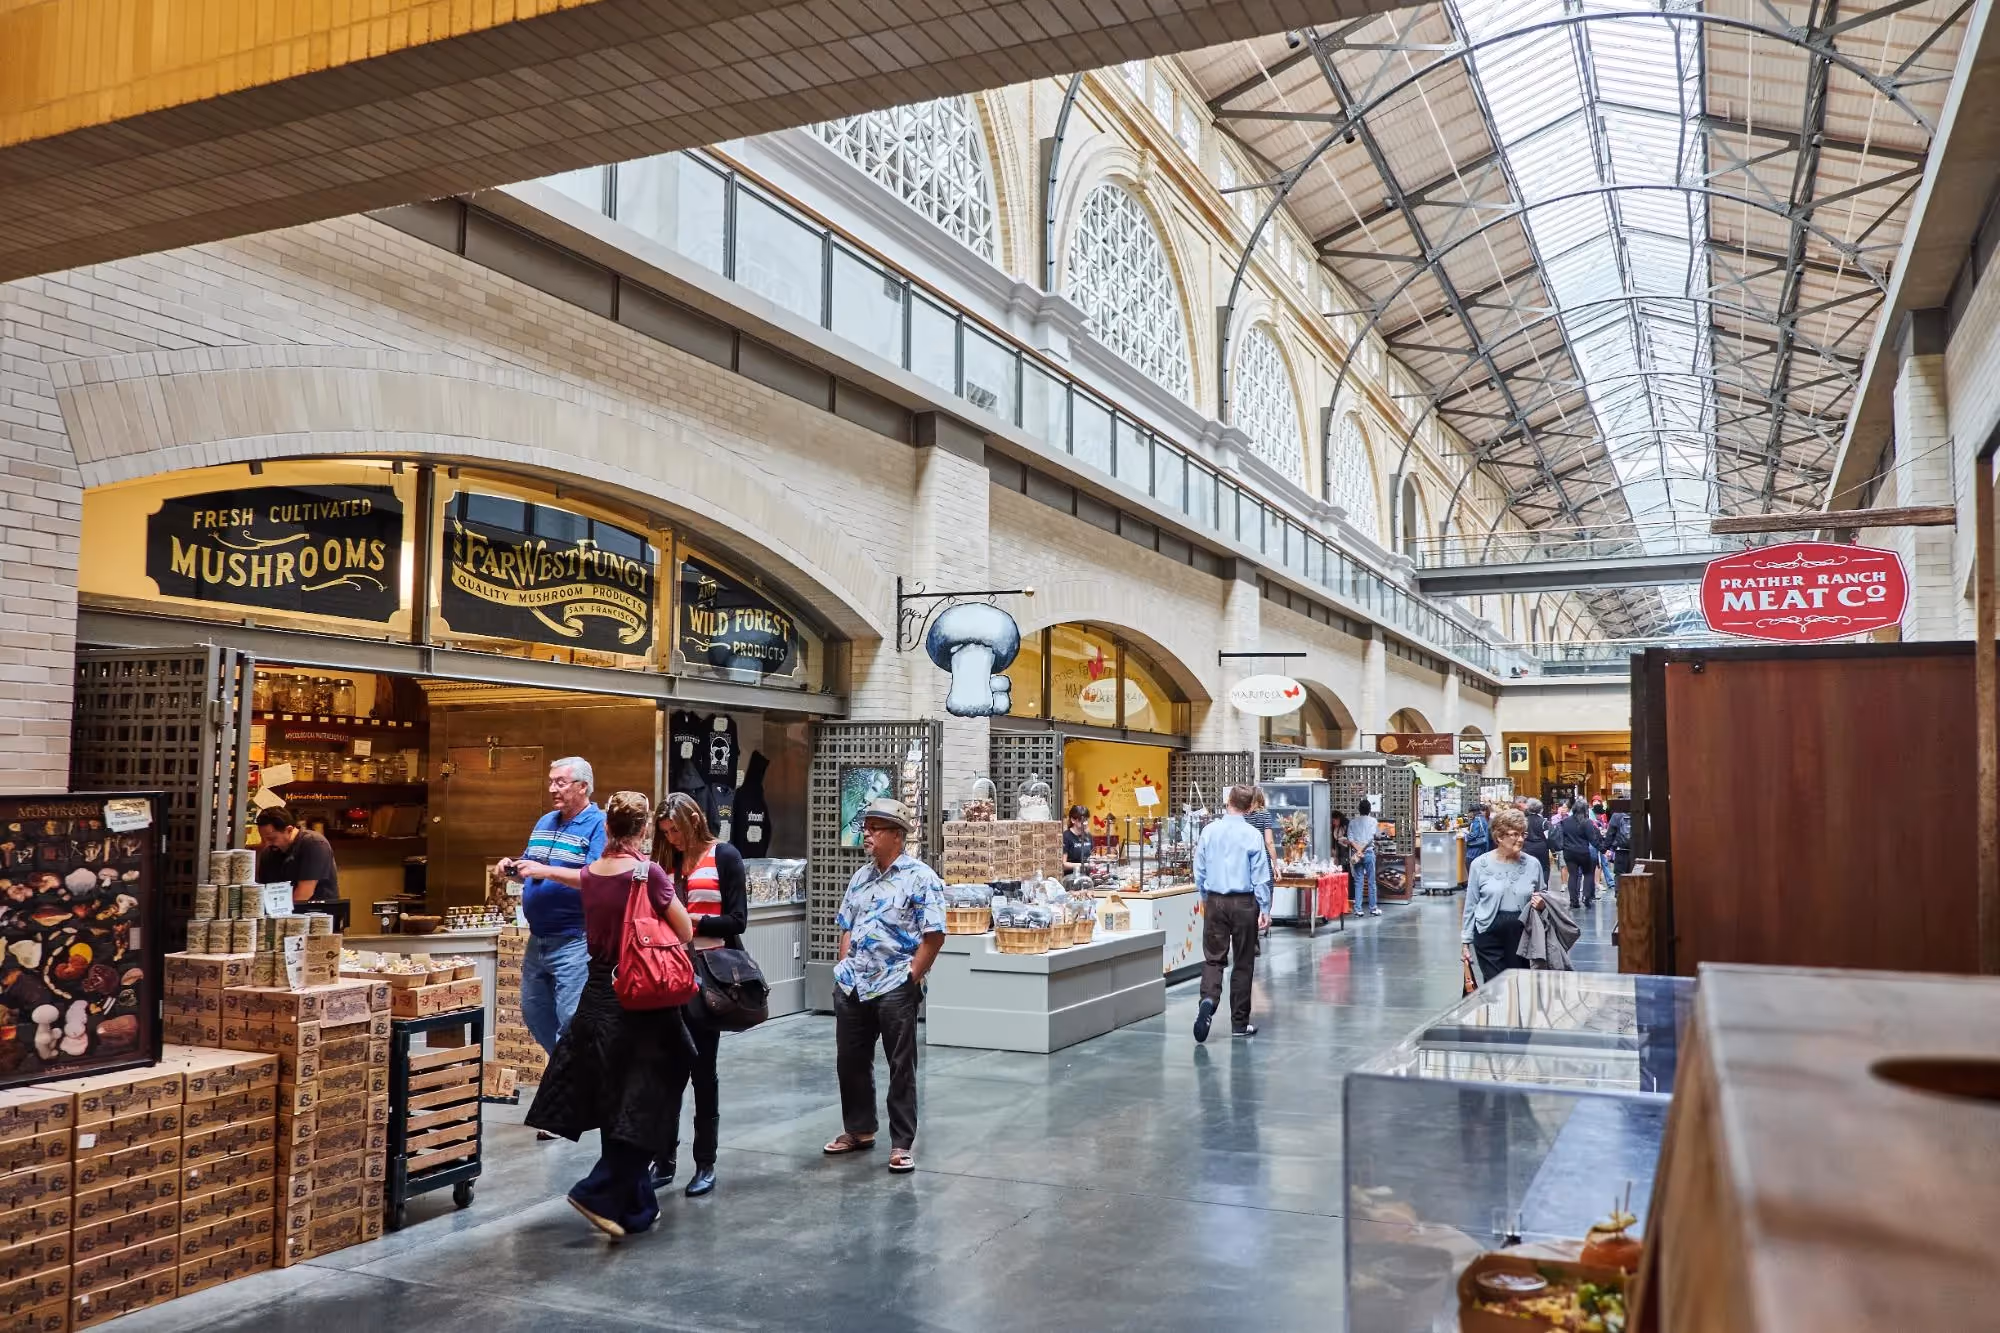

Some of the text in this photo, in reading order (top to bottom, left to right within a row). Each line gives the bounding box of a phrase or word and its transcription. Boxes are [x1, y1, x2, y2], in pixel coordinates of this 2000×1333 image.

[193, 498, 372, 529] FRESH CULTIVATED
[170, 535, 387, 588] MUSHROOMS
[458, 575, 643, 612] QUALITY MUSHROOM PRODUCTS
[697, 583, 717, 600] AND
[1720, 571, 1887, 590] PRATHER RANCH
[1720, 587, 1829, 613] MEAT
[569, 605, 636, 624] SAN FRANCISCO
[688, 604, 790, 642] WILD FOREST
[733, 641, 785, 661] PRODUCTS
